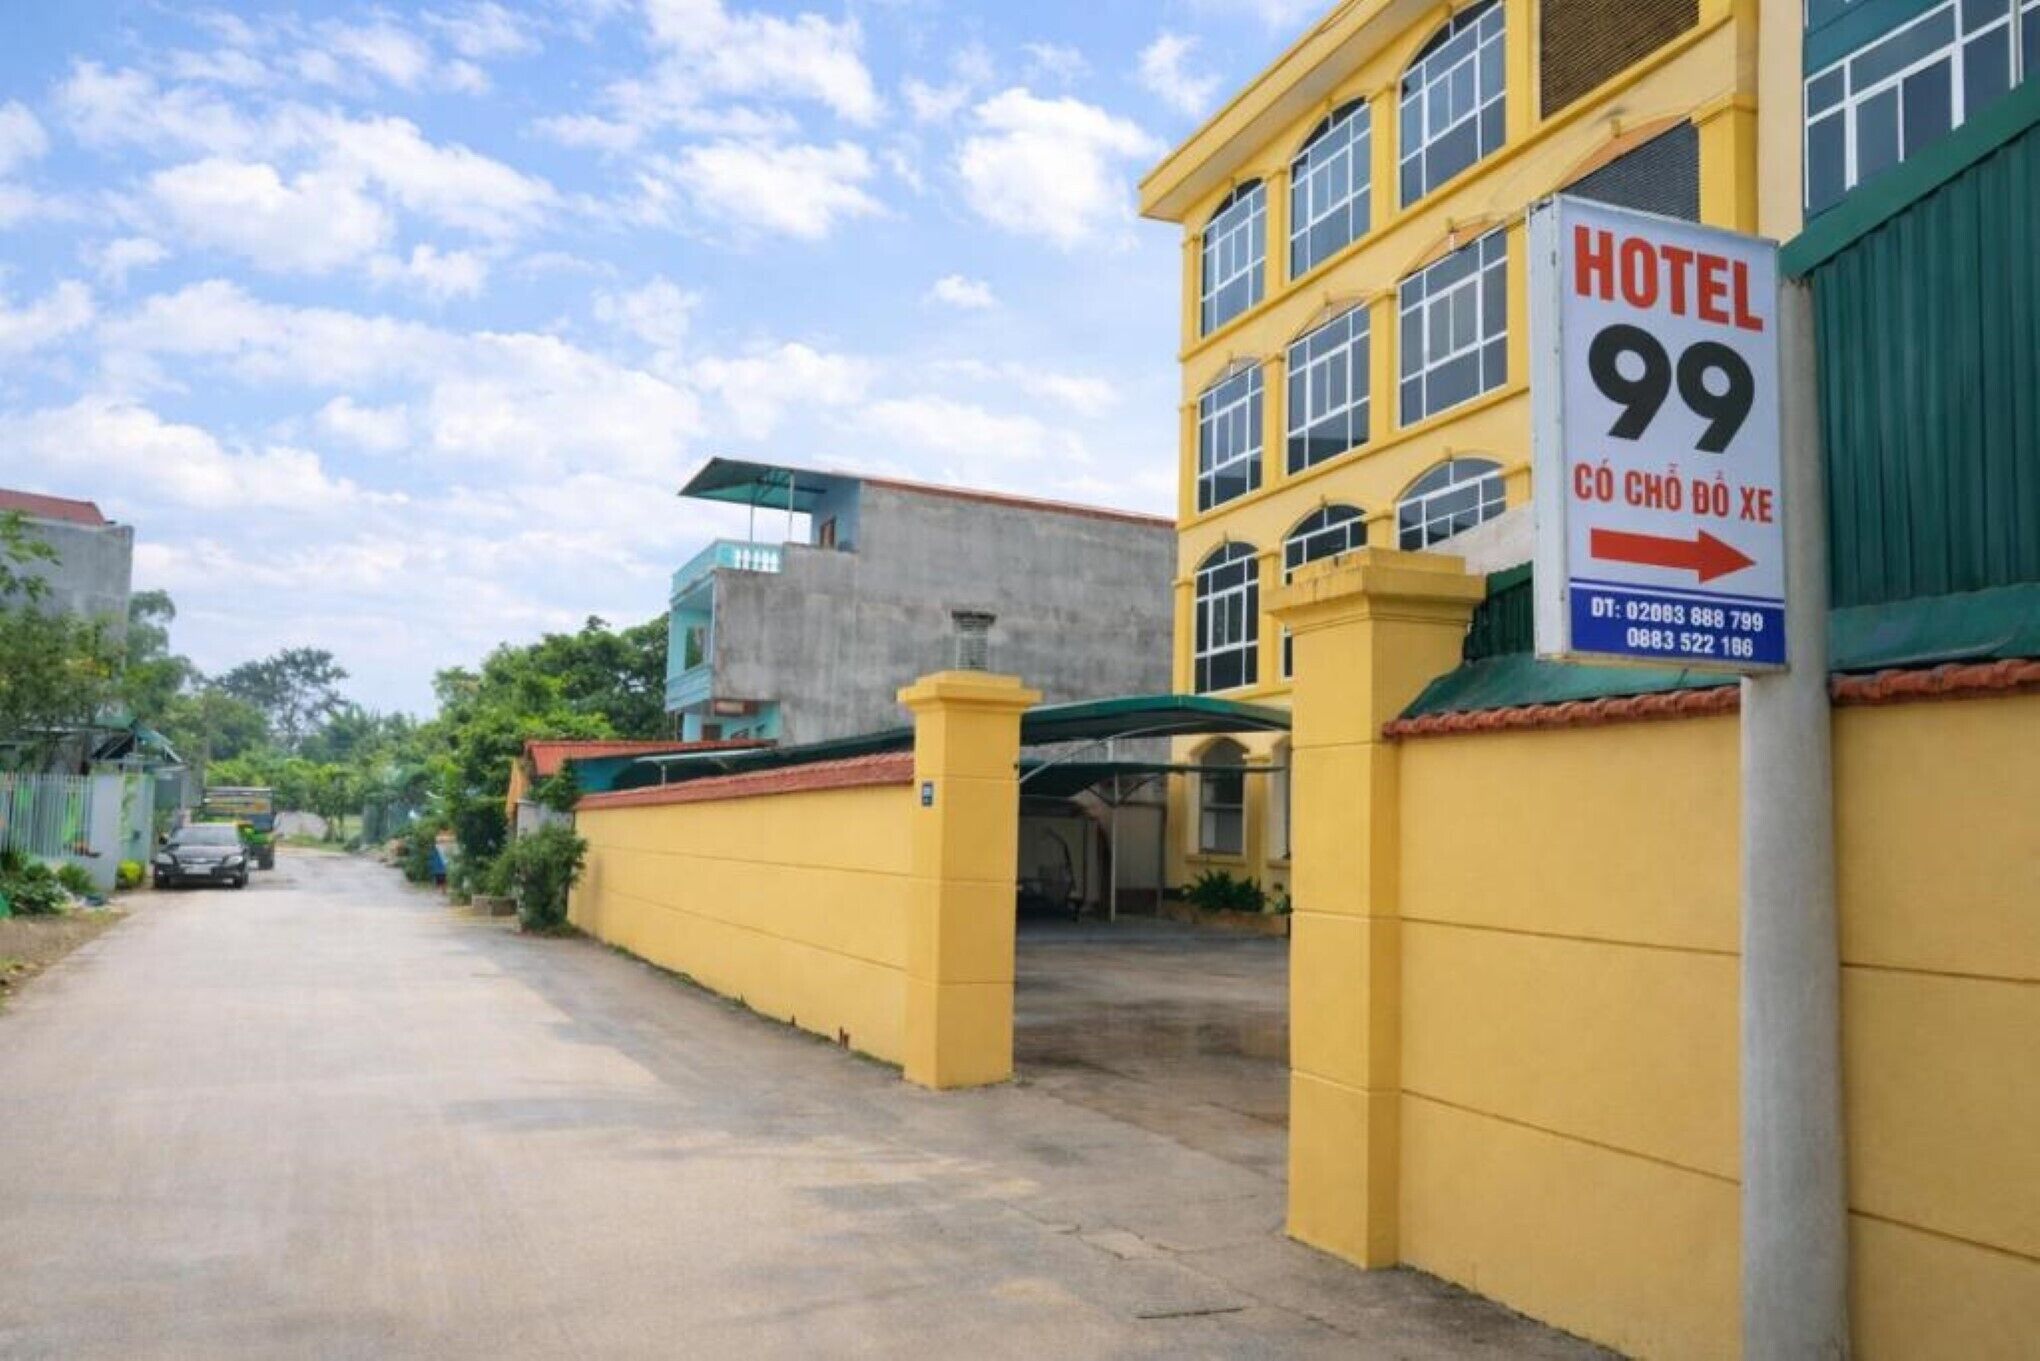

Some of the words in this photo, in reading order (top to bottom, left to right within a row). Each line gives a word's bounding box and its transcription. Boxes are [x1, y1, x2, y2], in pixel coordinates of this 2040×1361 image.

[1574, 224, 1764, 332] HOTEL
[1588, 323, 1755, 454] 99
[1574, 458, 1613, 502] CÓ
[1740, 486, 1773, 523] XE
[1680, 632, 1715, 654] 522
[1690, 606, 1725, 629] 888
